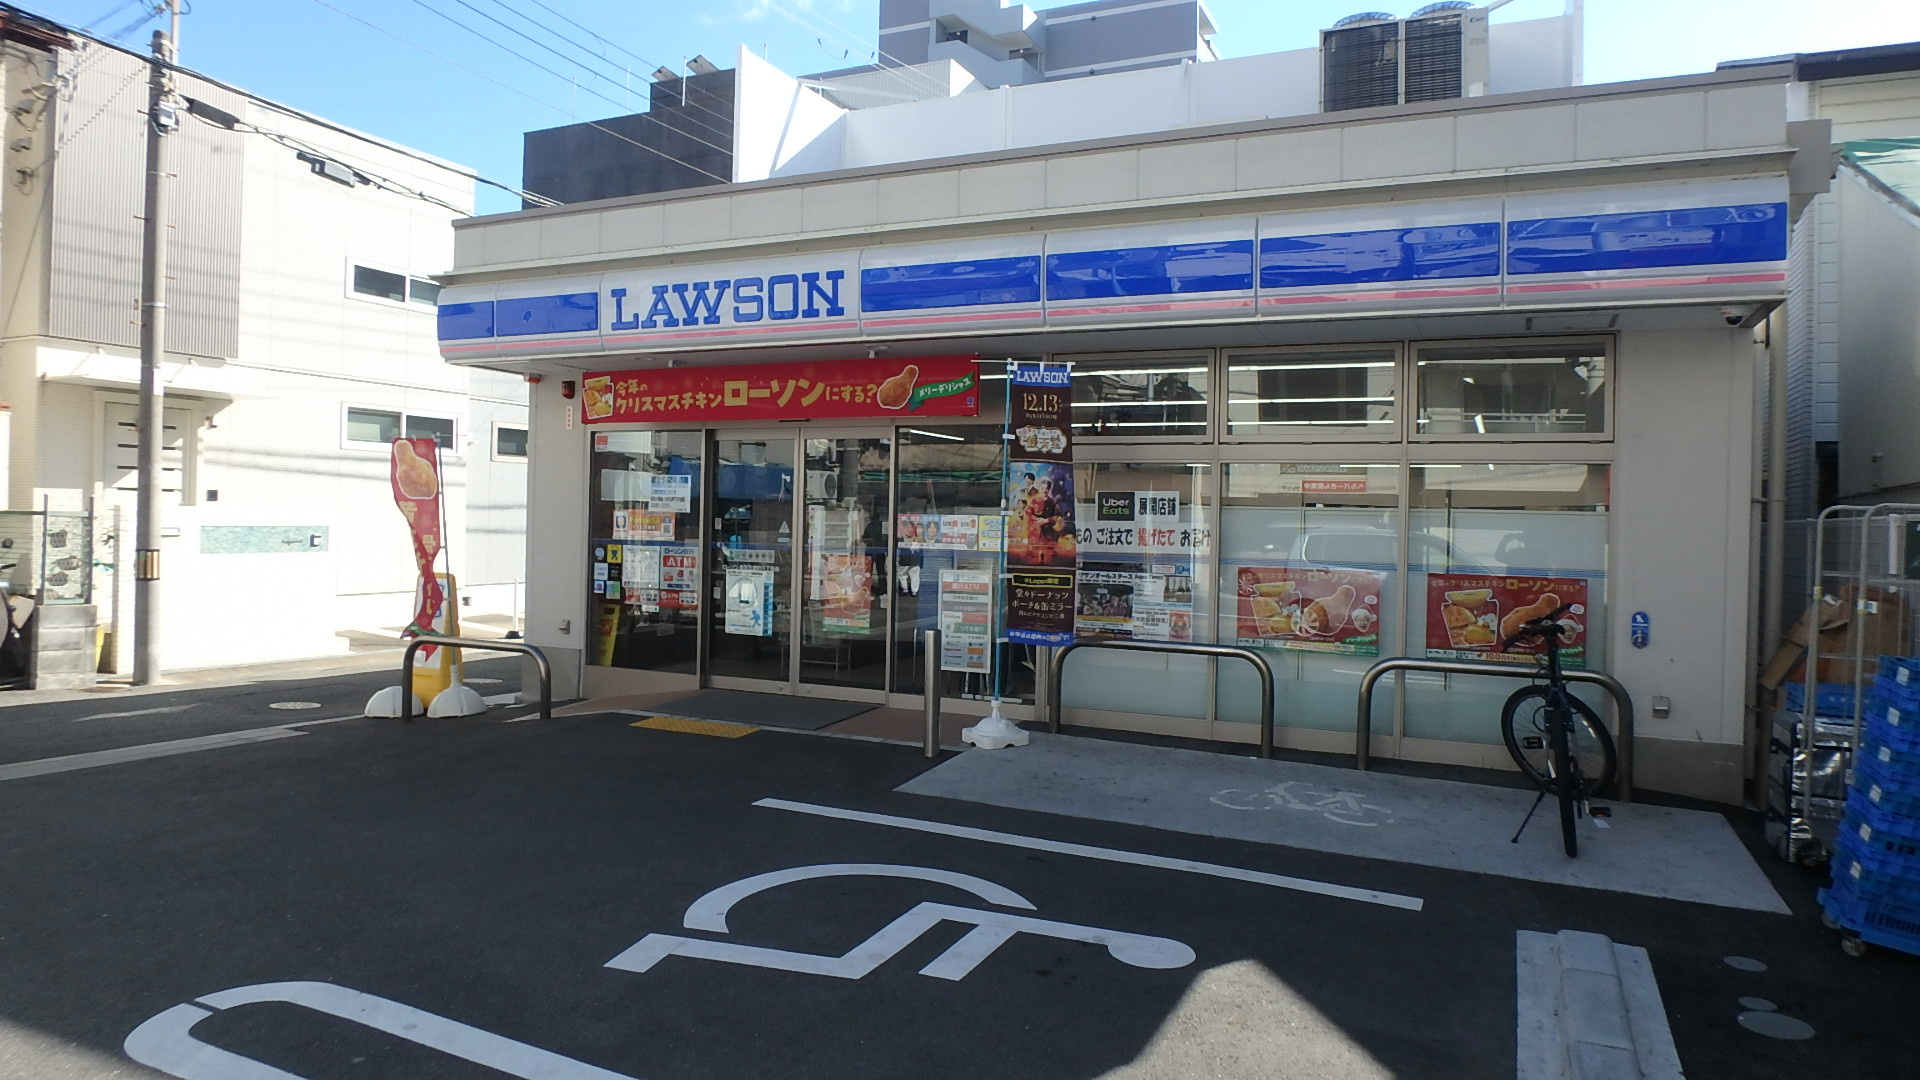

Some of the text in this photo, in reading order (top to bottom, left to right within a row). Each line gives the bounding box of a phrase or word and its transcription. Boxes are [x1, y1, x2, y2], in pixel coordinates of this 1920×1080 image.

[611, 270, 844, 331] LAWSON
[1016, 371, 1068, 384] LAWSON
[615, 379, 648, 397] 今年の
[918, 377, 972, 398] メリーデリシャス
[1023, 393, 1058, 412] 12.13
[1103, 498, 1130, 507] Uber
[1103, 507, 1130, 516] Eats
[1139, 497, 1177, 516] 展開店舗
[1096, 528, 1133, 546] ご注文で
[1137, 528, 1176, 547] 揚げたて
[668, 557, 692, 567] ATM
